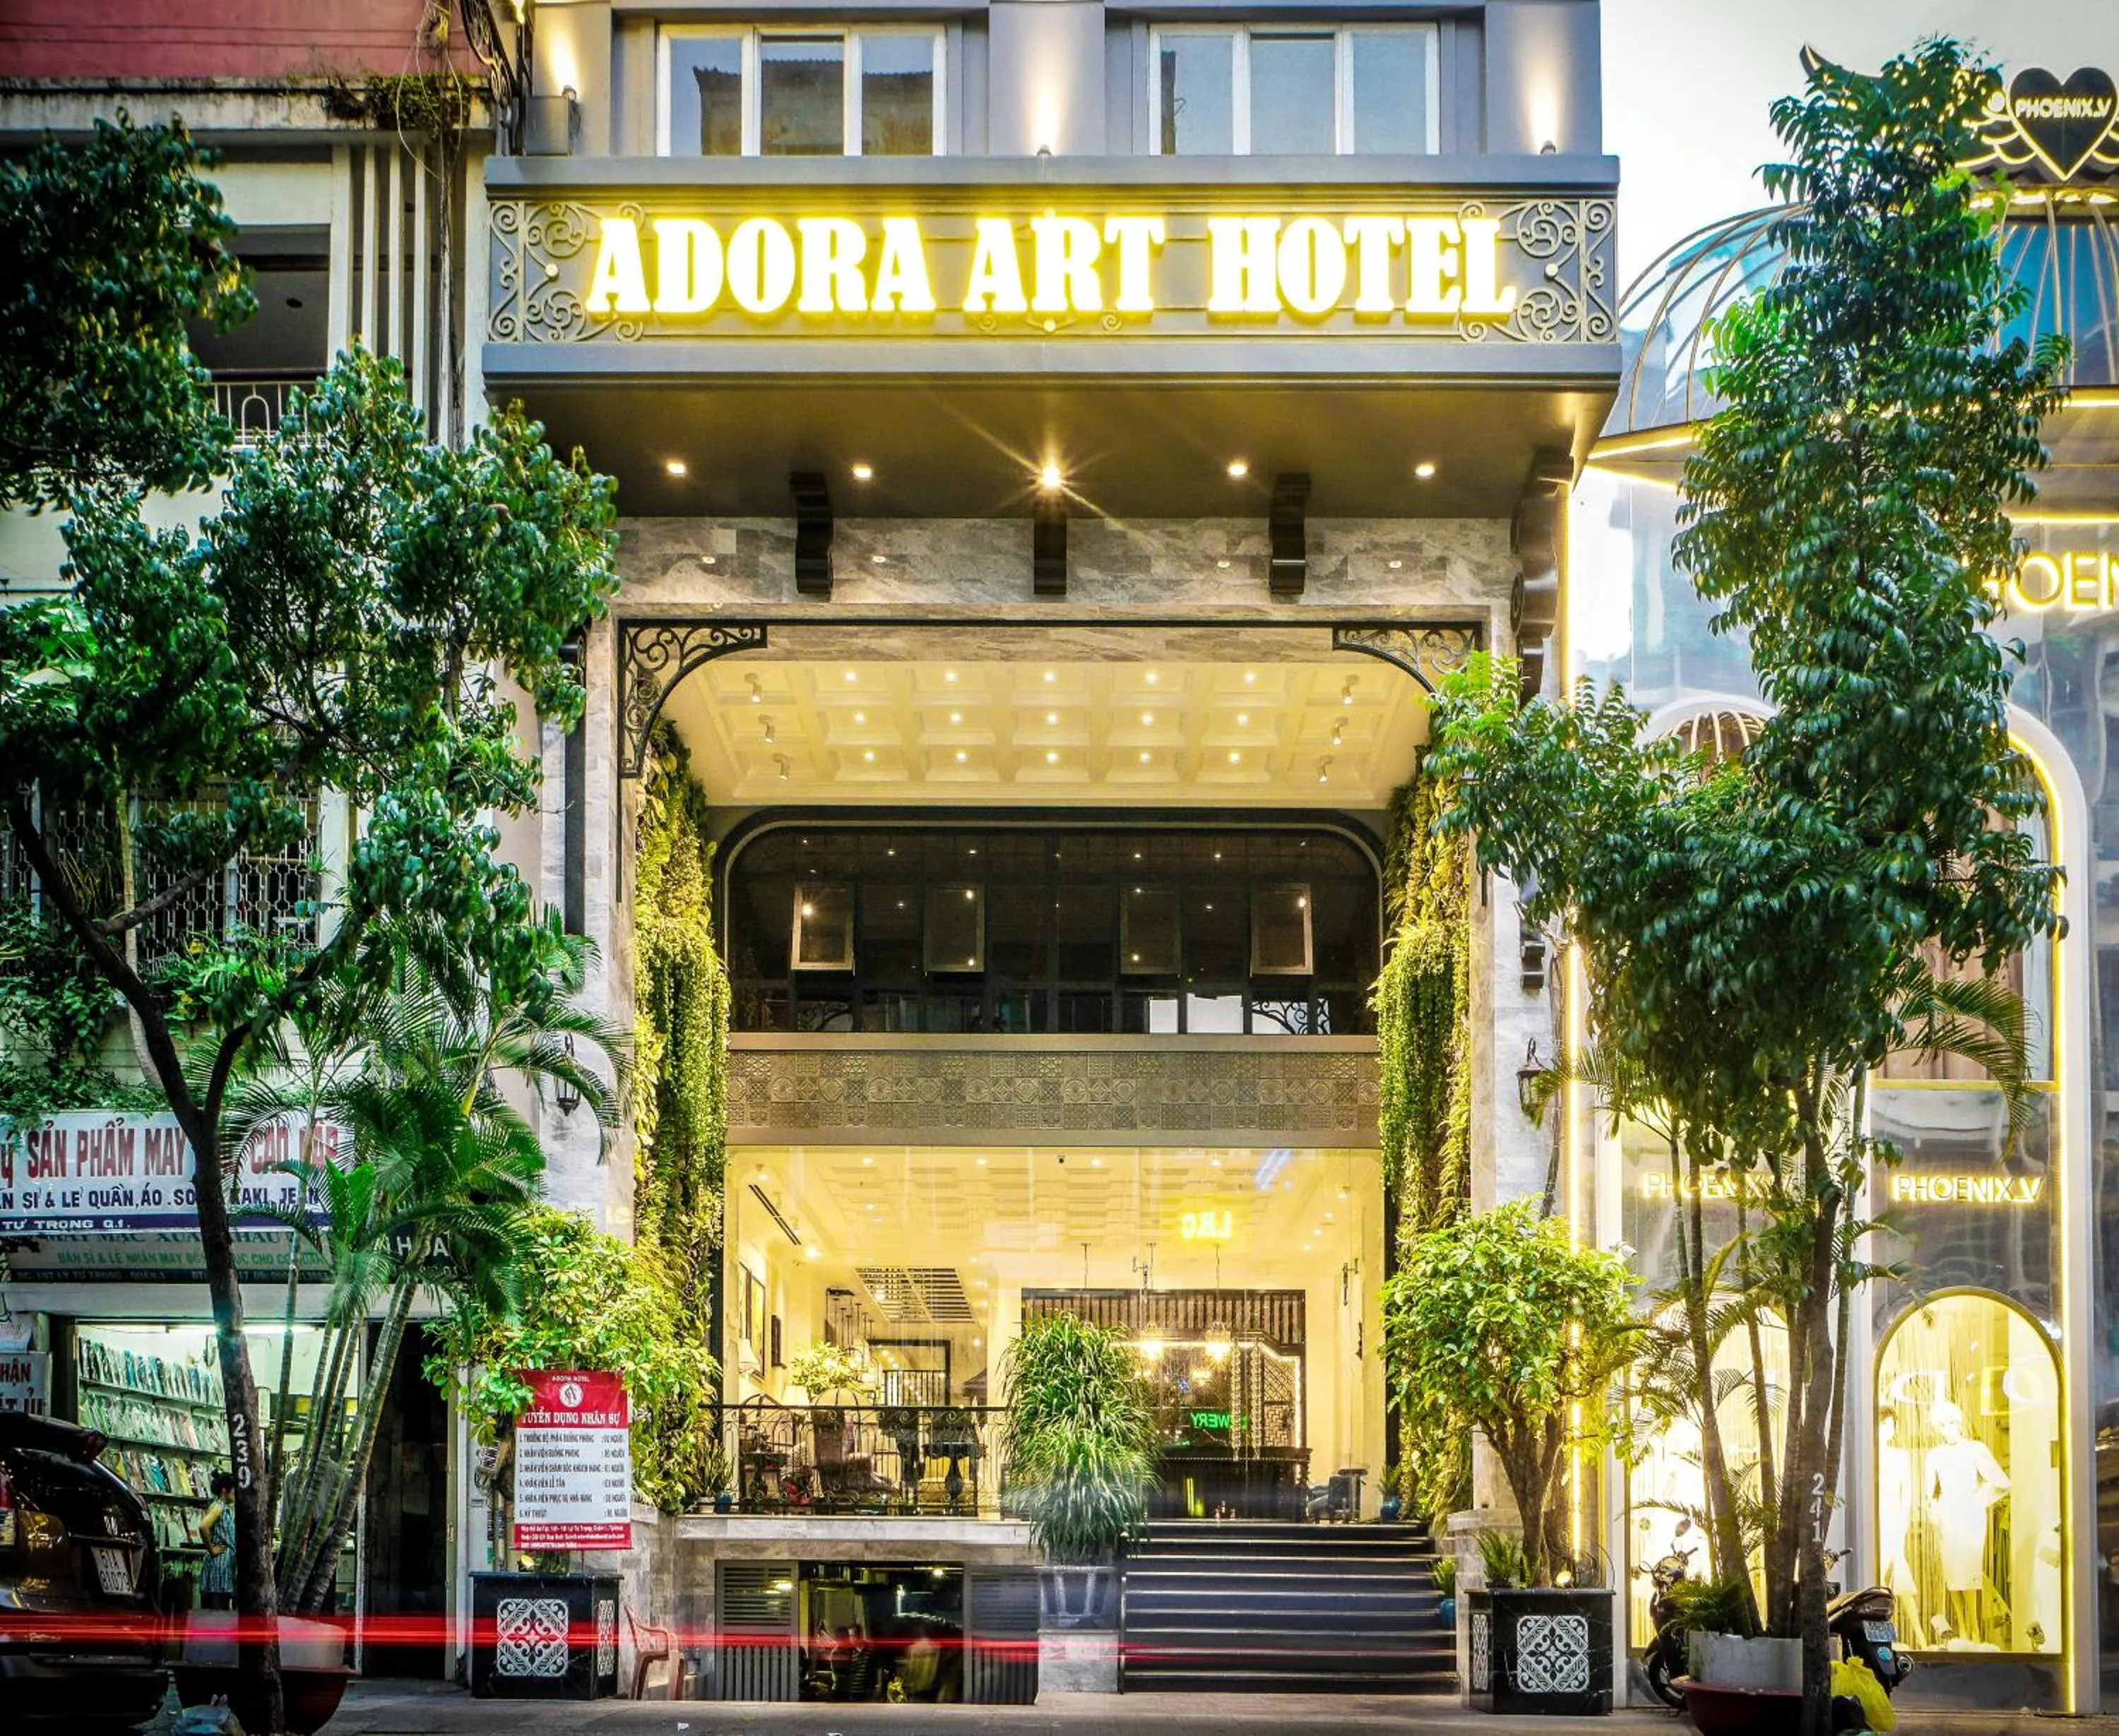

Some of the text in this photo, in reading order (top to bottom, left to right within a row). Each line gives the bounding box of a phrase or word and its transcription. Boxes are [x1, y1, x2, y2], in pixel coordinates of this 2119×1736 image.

[586, 216, 1518, 315] ADORA ART HOTEL
[27, 1120, 67, 1178] SẢN
[77, 1117, 135, 1177] PHẨM
[145, 1127, 186, 1176] MAY
[44, 1190, 55, 1208] &
[280, 1187, 319, 1205] JEN
[232, 1413, 251, 1489] 239
[1809, 1473, 1824, 1542] 241
